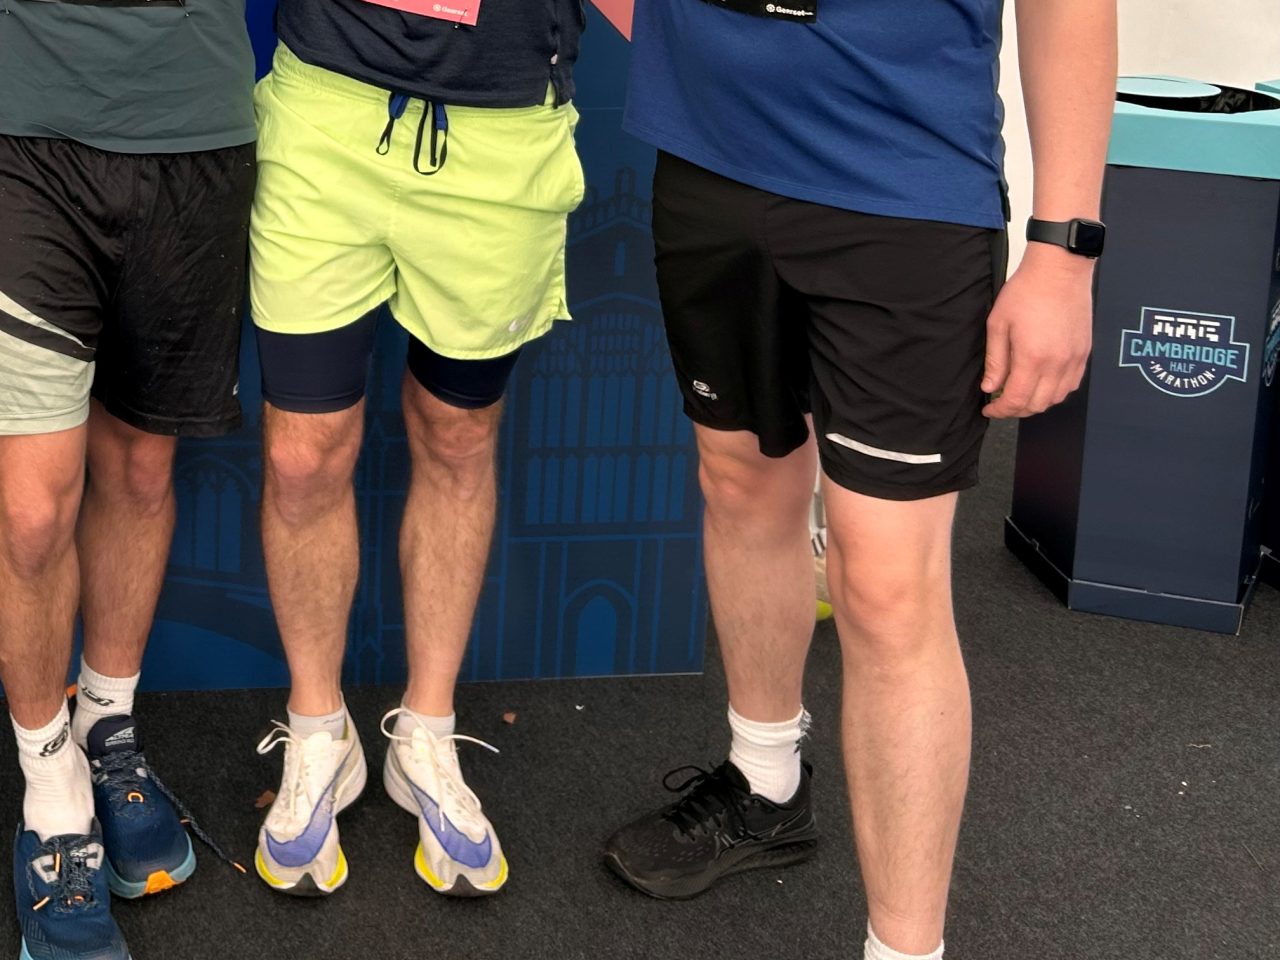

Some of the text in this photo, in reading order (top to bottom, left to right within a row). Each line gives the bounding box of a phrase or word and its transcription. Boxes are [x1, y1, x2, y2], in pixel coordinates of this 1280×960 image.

[1130, 338, 1239, 369] CAMBRIDGE
[1149, 363, 1216, 389] MARATHON
[1169, 361, 1196, 374] HALF
